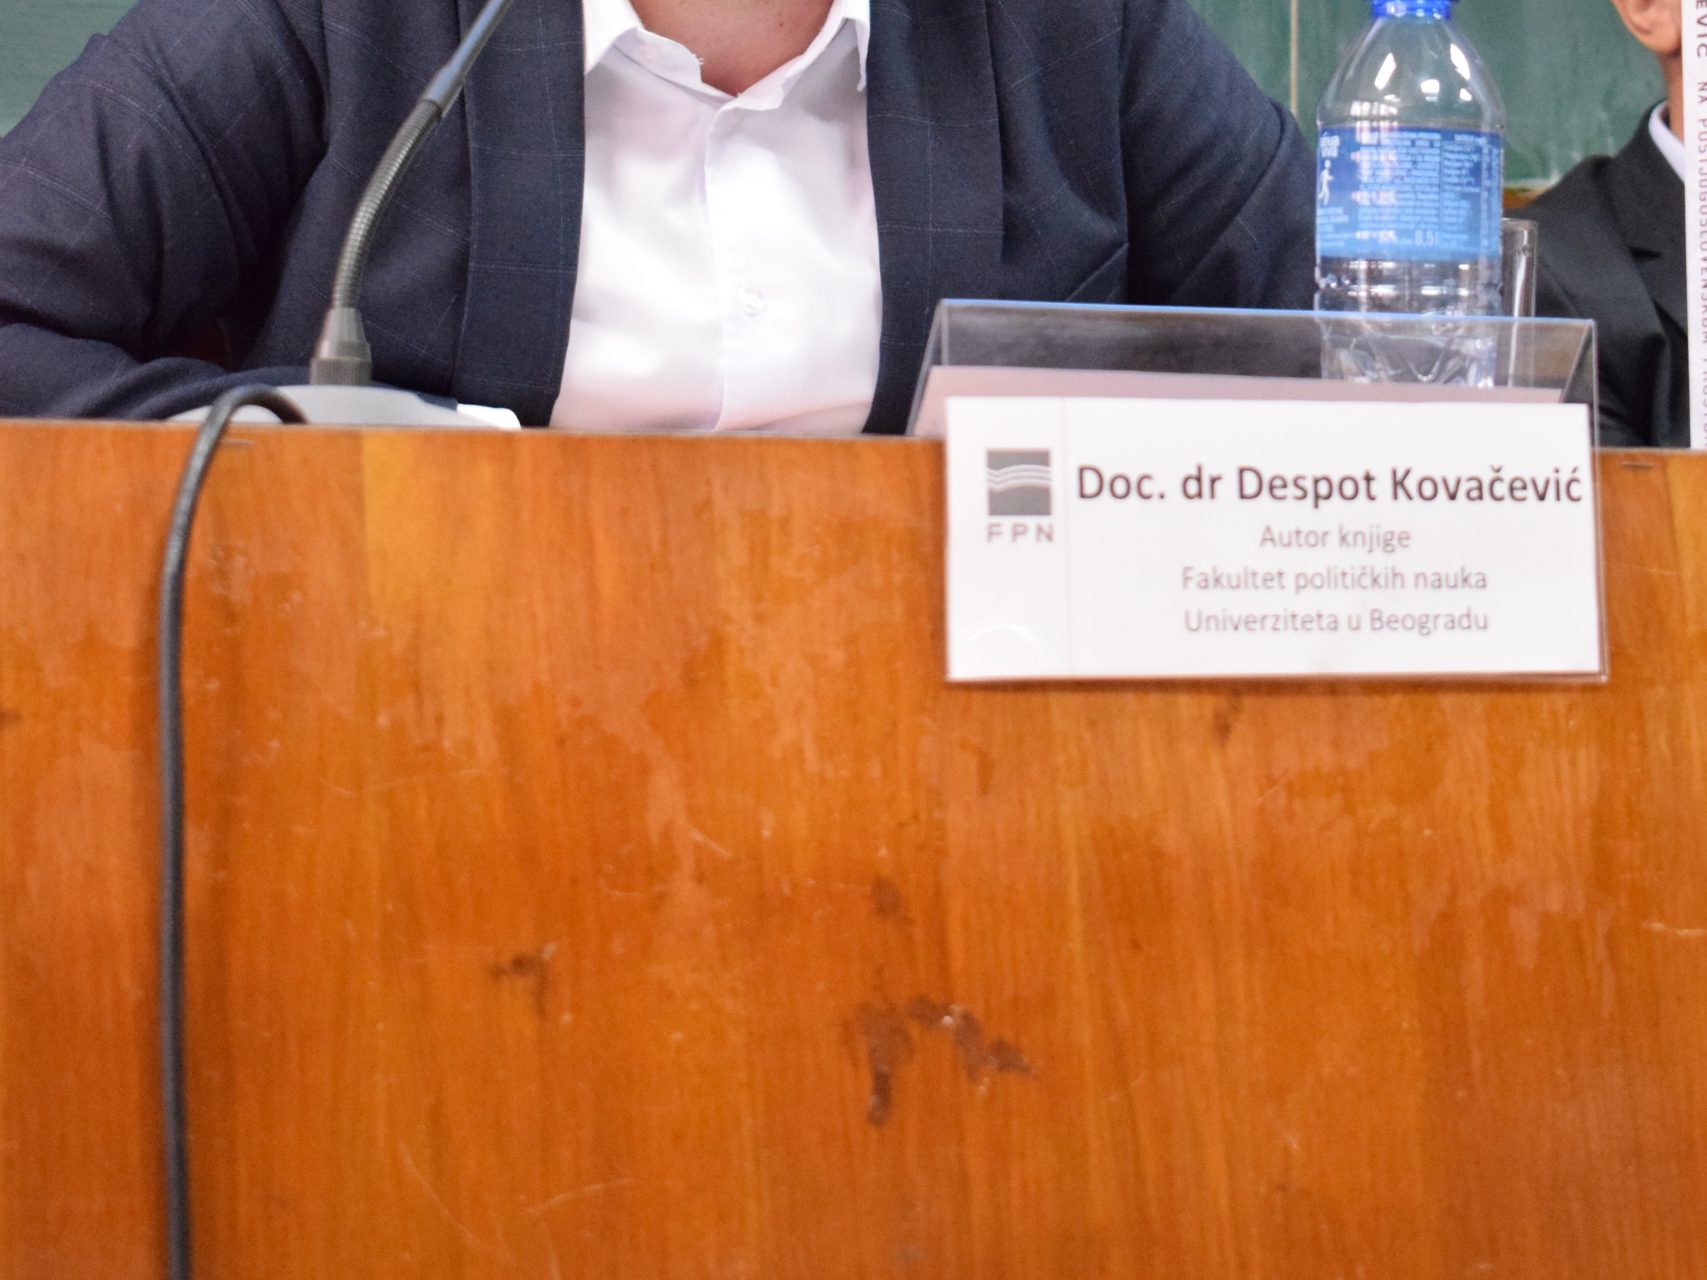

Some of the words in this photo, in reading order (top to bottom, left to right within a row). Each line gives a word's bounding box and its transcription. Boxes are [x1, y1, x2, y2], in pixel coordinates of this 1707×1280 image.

[1078, 465, 1165, 501] Doc.
[1181, 464, 1223, 501] dr
[1237, 466, 1377, 510] Despot
[1391, 466, 1582, 503] Kovačević
[987, 522, 1055, 543] FPN
[1259, 525, 1330, 548] Autor
[1338, 525, 1411, 553] knjige
[1182, 566, 1286, 590] Fakultet
[1295, 565, 1405, 594] političkih
[1414, 567, 1487, 590] nauka
[1184, 609, 1339, 633] Univerziteta
[1348, 616, 1361, 632] u
[1369, 608, 1488, 635] Beogradu
